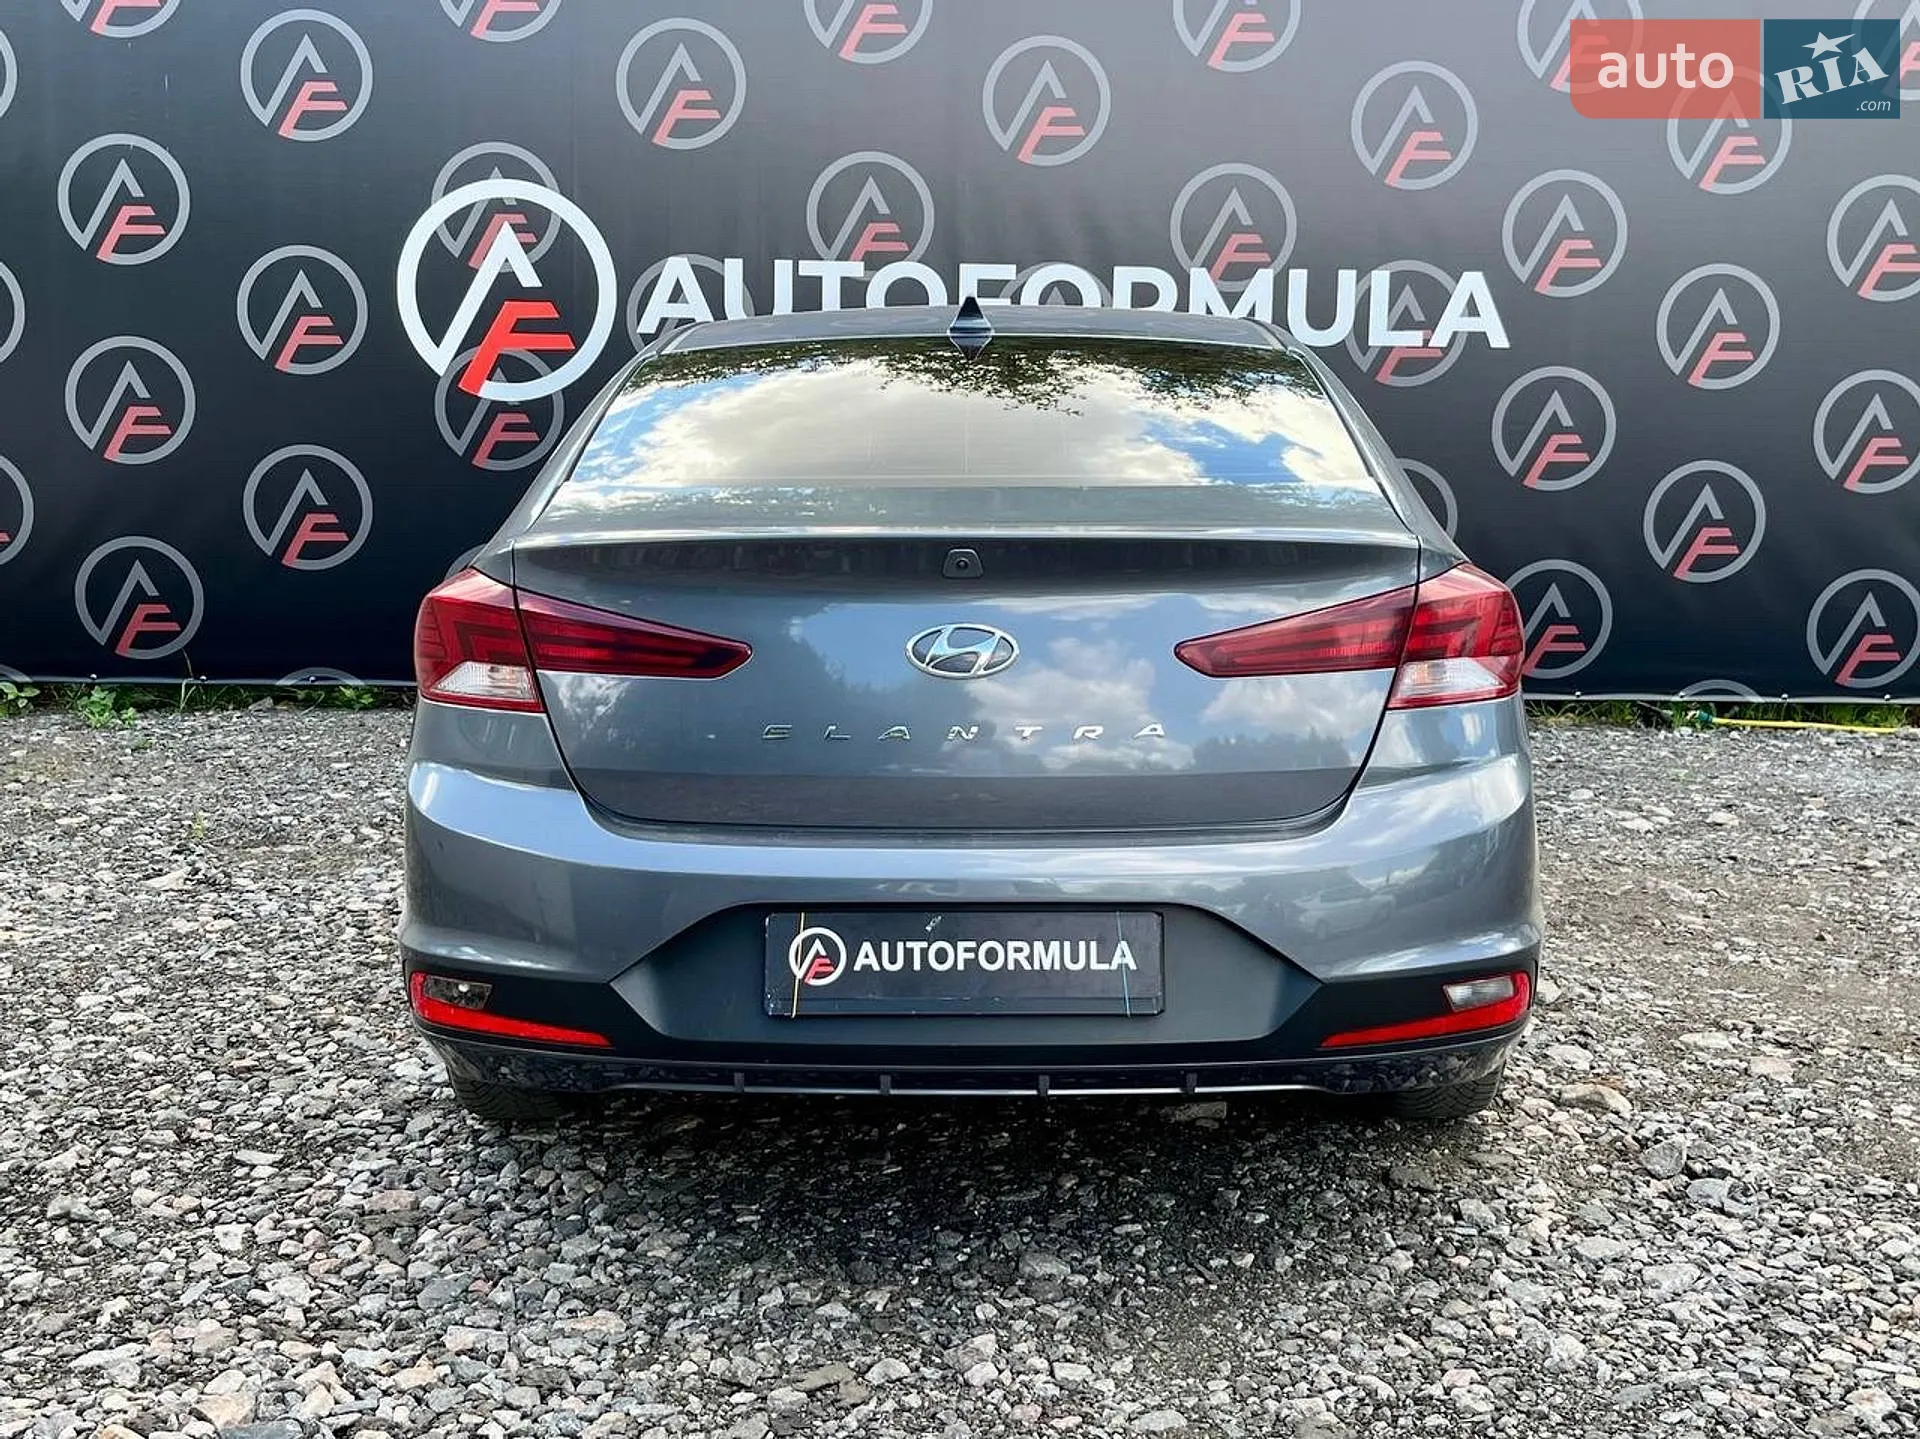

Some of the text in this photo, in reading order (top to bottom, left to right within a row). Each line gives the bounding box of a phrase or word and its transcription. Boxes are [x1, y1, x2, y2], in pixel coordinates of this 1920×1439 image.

[636, 256, 1510, 350] AUTOFORMULA
[762, 723, 1166, 741] ELANTRA
[853, 940, 1138, 972] AUTOFORMULA
